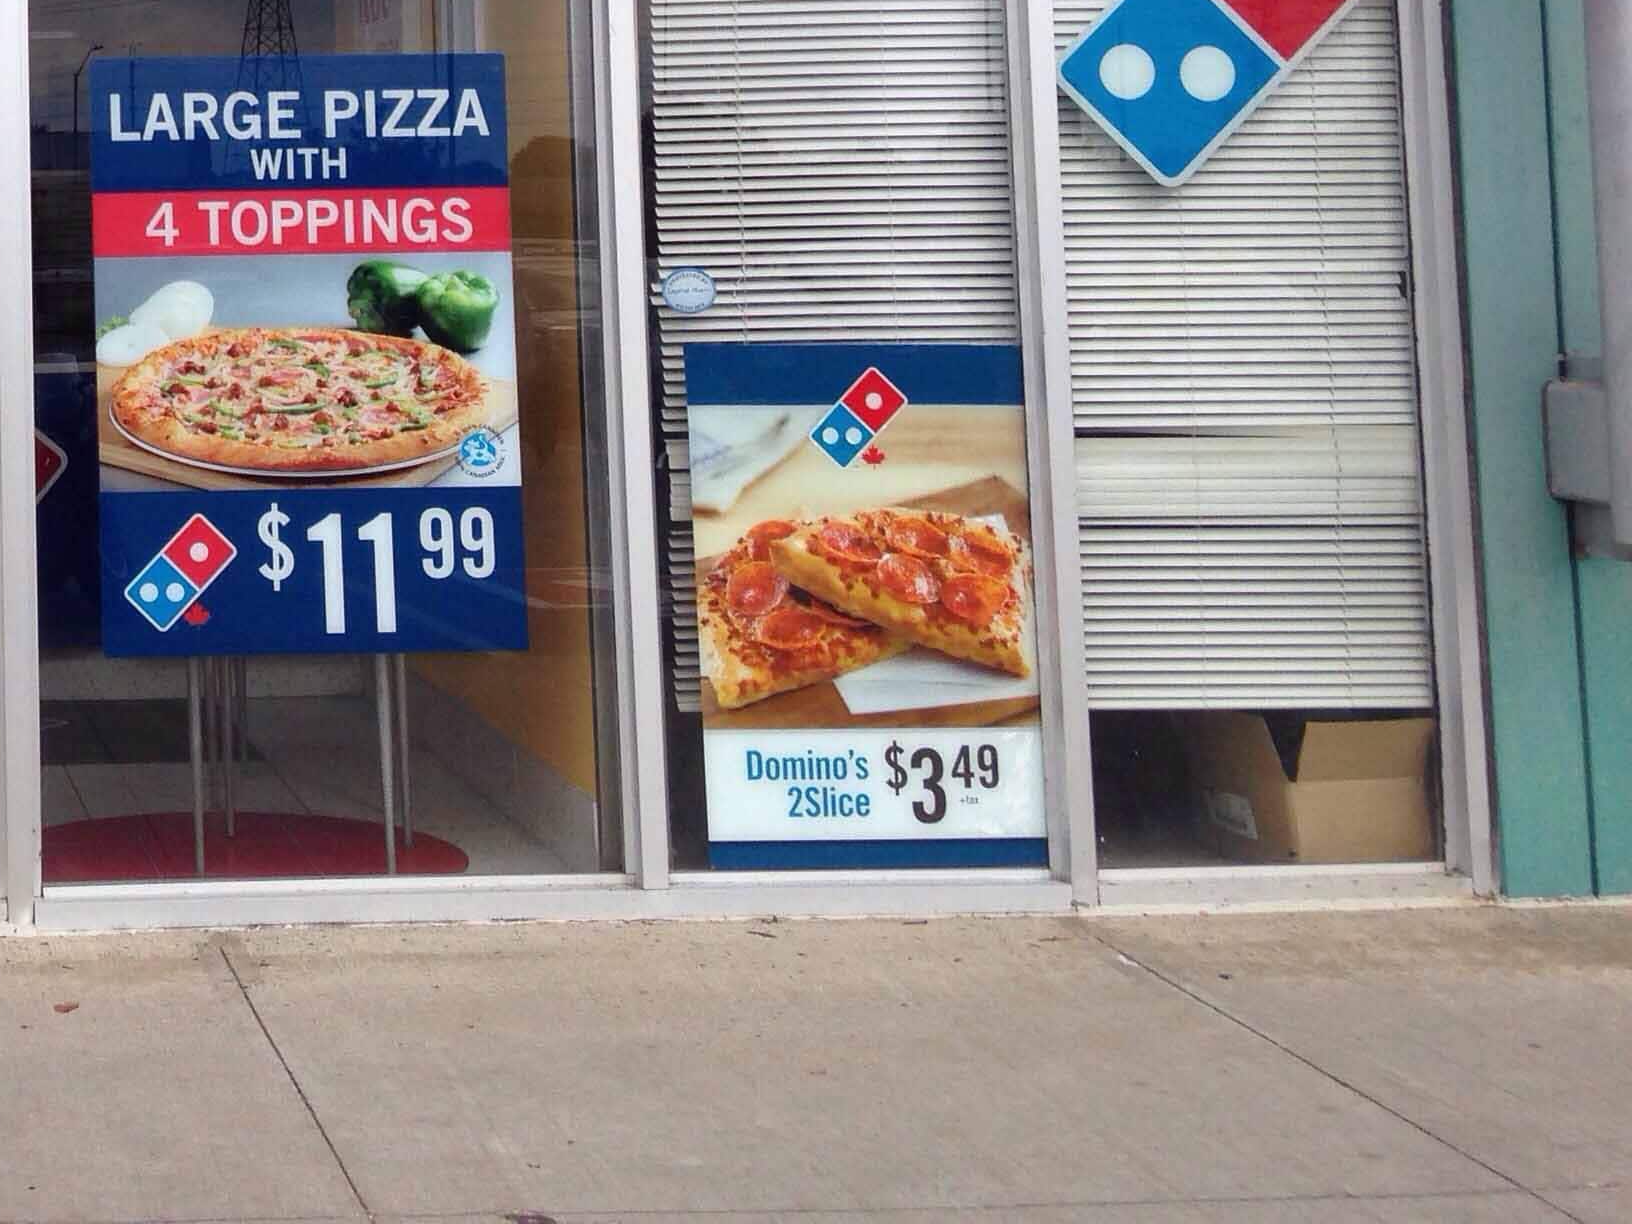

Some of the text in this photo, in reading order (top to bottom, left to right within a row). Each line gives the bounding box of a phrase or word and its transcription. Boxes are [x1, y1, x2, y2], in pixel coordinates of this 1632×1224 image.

[108, 88, 491, 142] LARGE PIZZA
[250, 147, 347, 181] WITH
[145, 197, 474, 247] 4 TOPPINGS
[746, 748, 869, 782] Domino's
[787, 786, 871, 818] 2Slice
